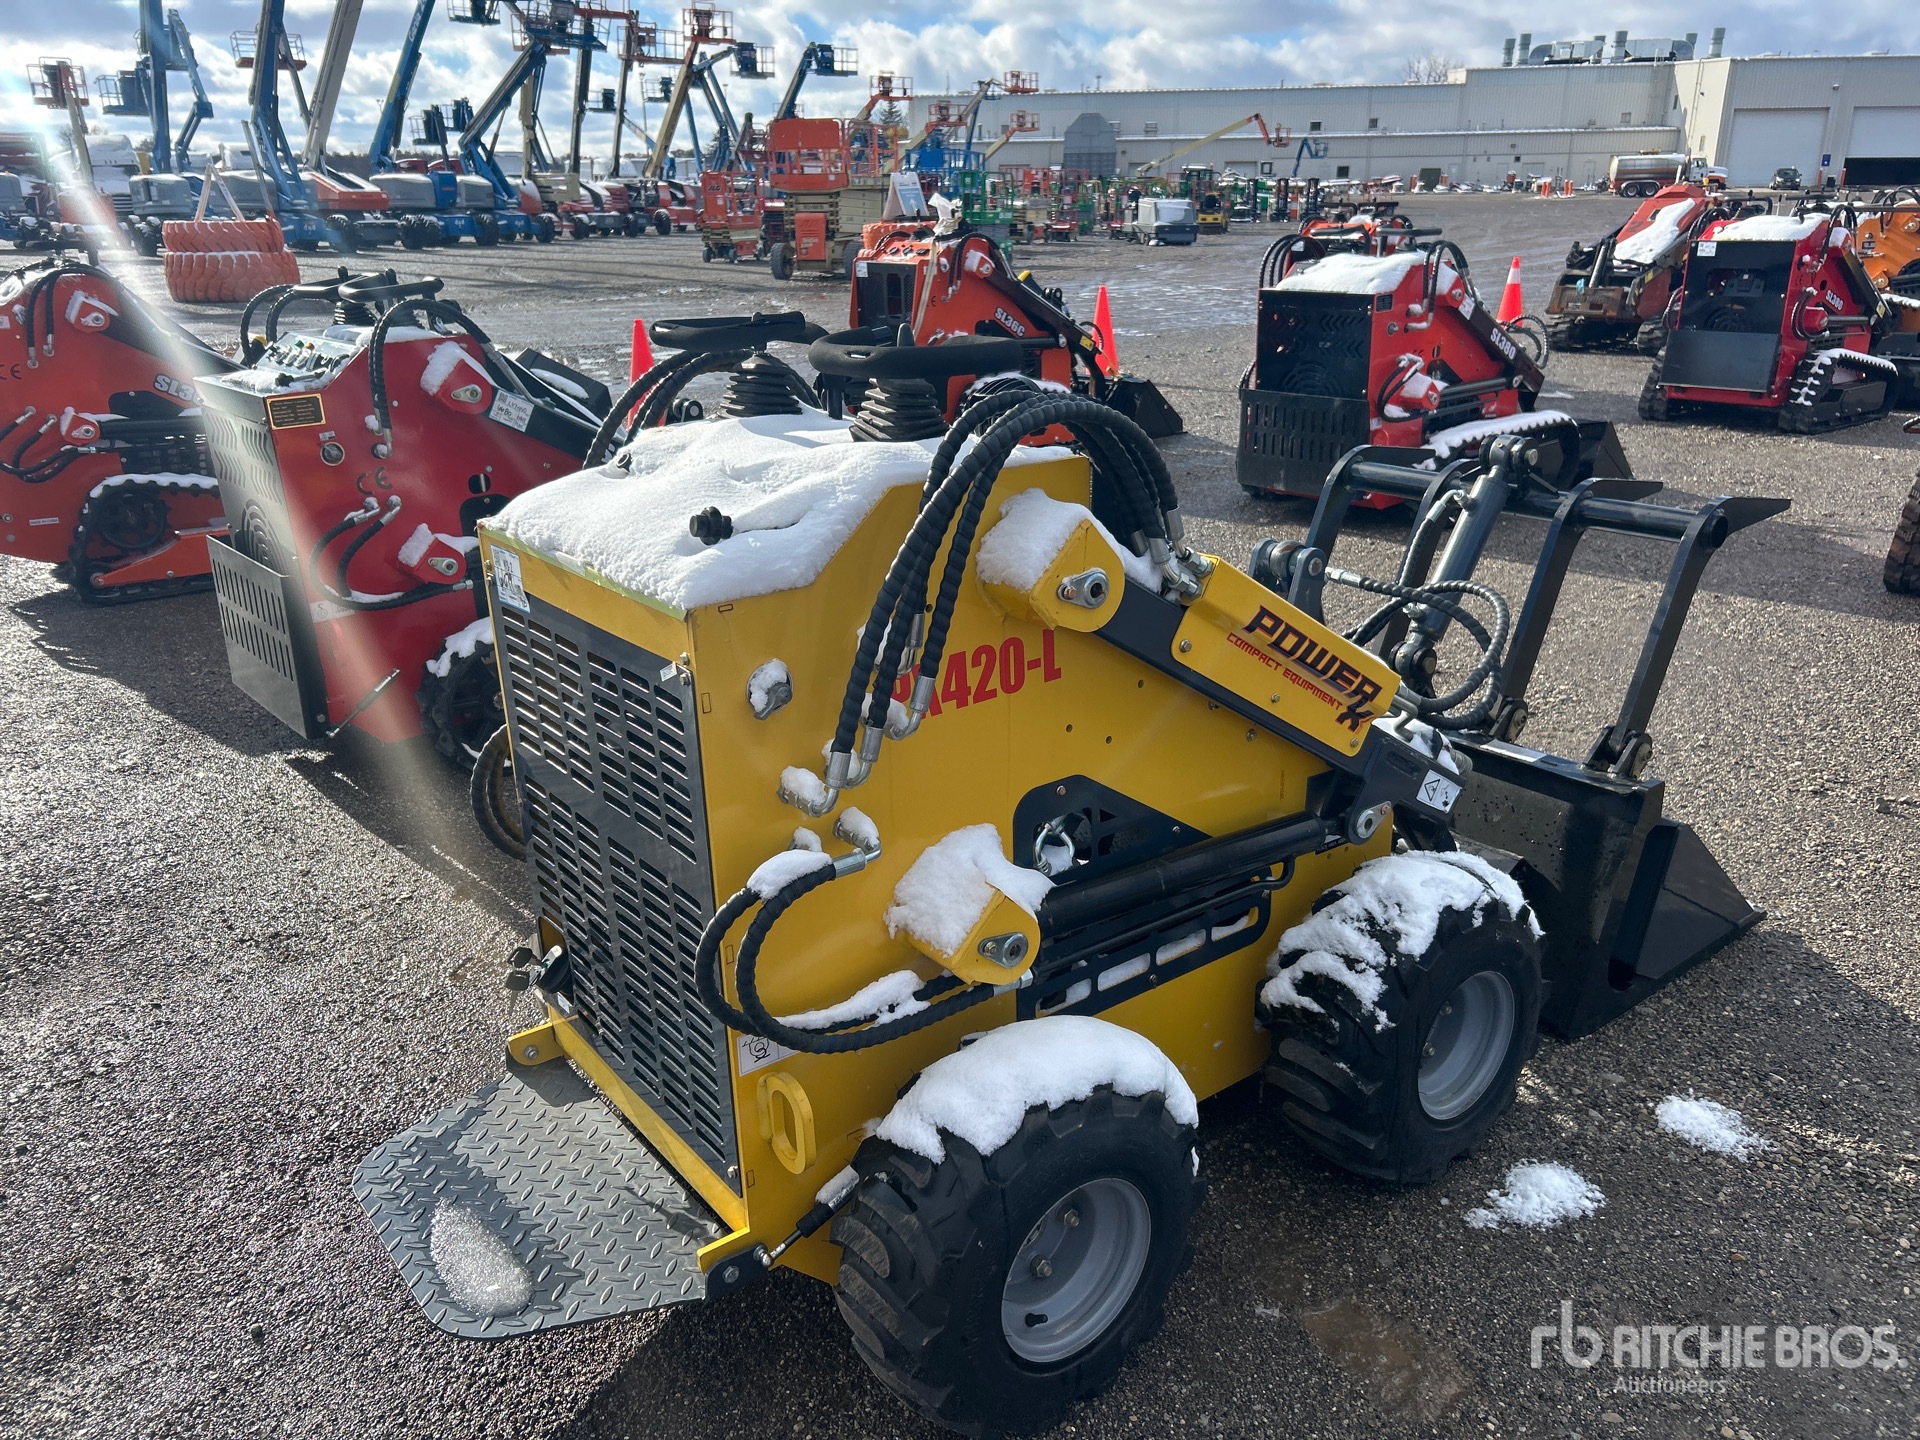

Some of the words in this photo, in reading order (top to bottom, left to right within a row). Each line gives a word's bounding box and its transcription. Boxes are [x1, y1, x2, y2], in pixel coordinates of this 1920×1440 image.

[994, 306, 1026, 337] SL36C
[1490, 327, 1517, 360] SL380
[1226, 632, 1282, 671] COMPACT
[1282, 667, 1343, 710] EQUIPMENT
[1242, 605, 1383, 703] POWER
